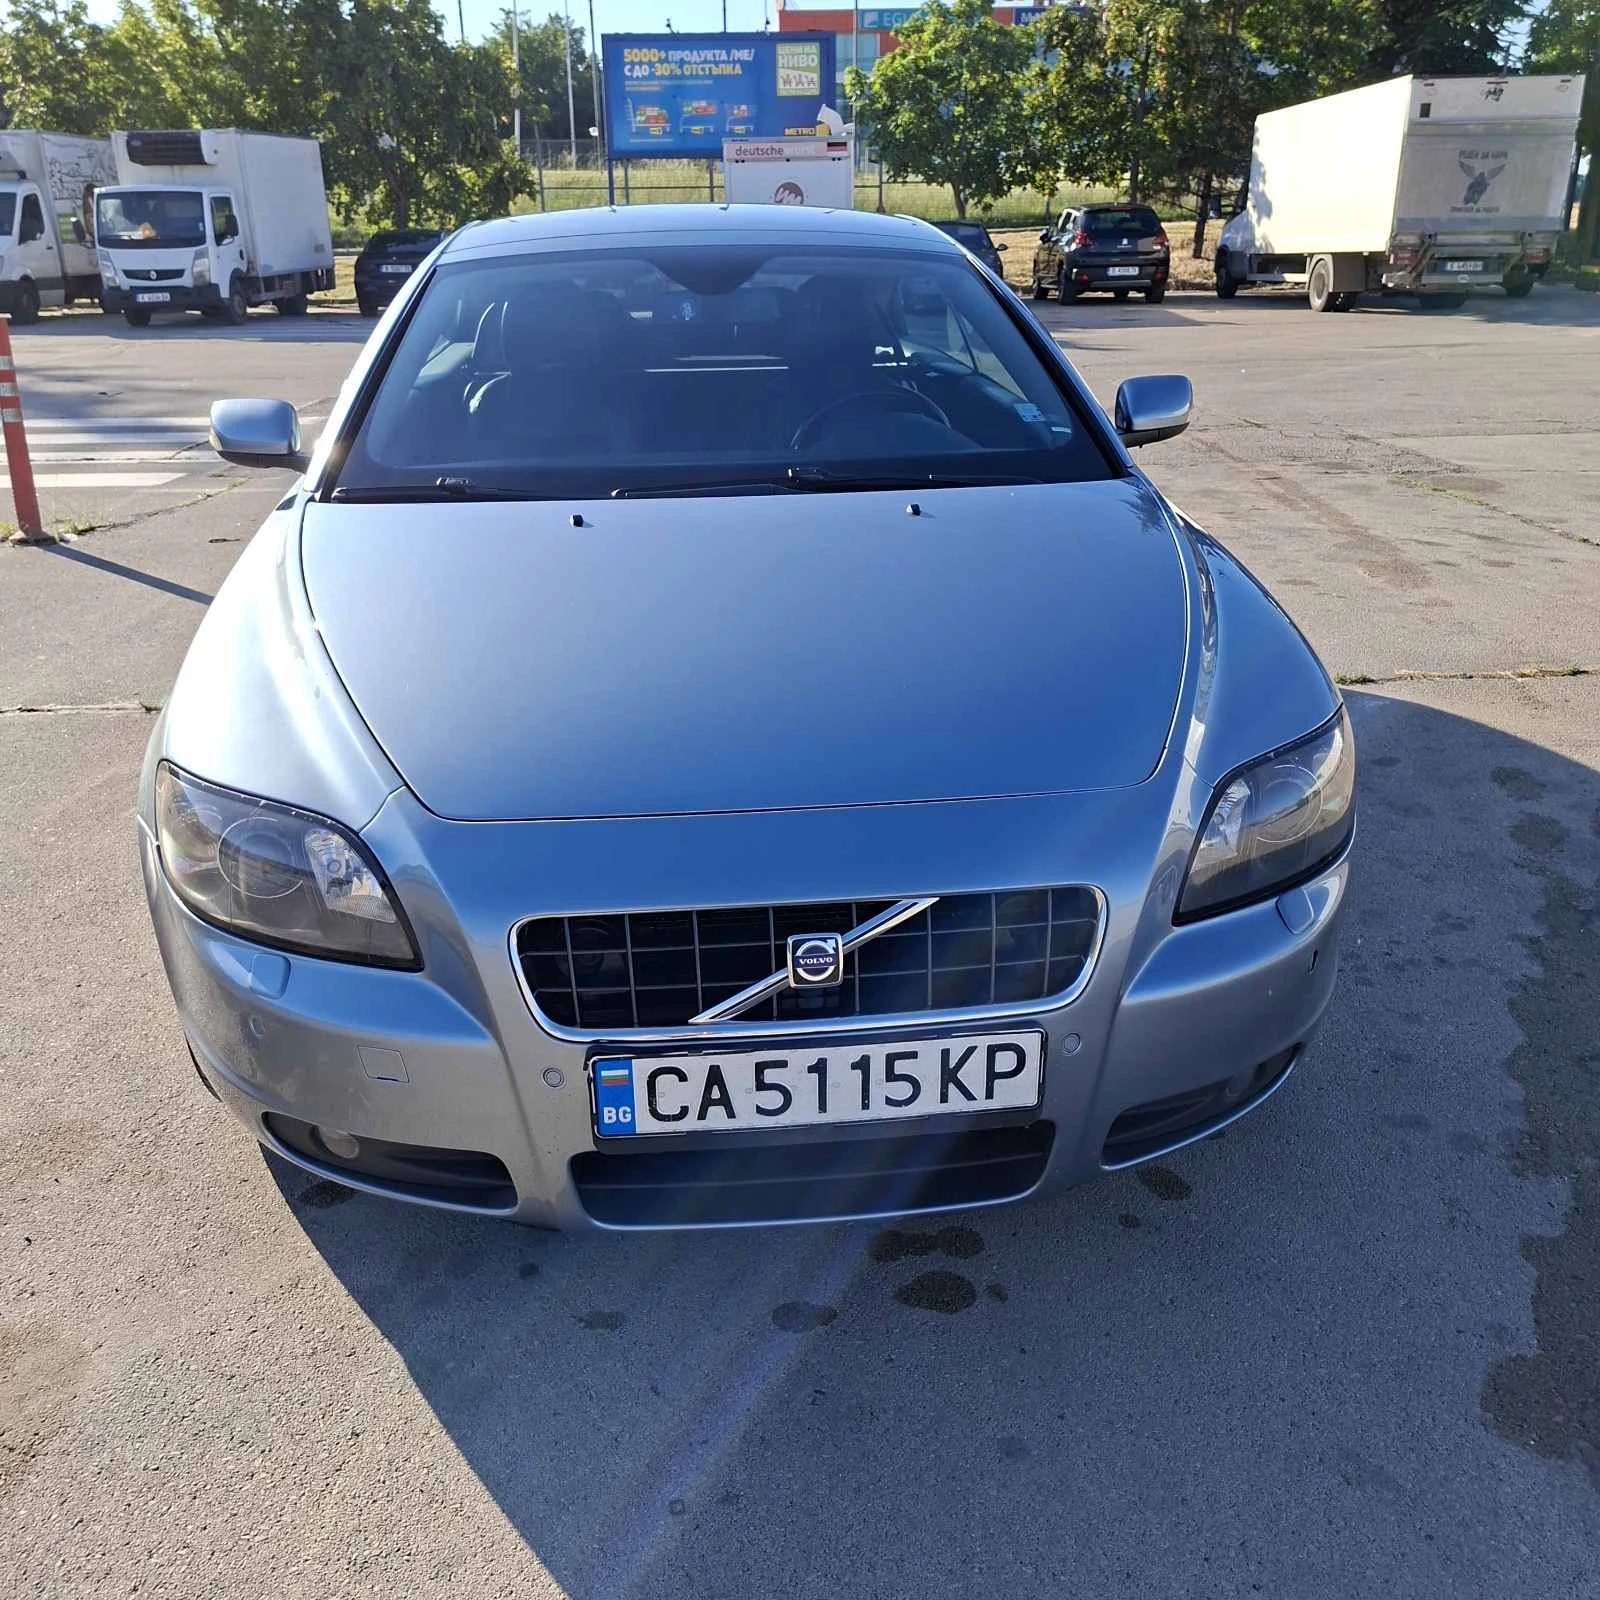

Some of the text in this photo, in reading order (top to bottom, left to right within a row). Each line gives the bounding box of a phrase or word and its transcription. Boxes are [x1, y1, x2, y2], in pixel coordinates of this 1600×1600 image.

[623, 48, 667, 62] 5000+
[668, 49, 728, 63] ПРОДУКТА
[779, 54, 817, 68] НИВО
[683, 63, 742, 76] ОТСТЪПКА
[784, 127, 815, 136] METRO
[735, 145, 784, 157] deutsche
[799, 956, 833, 965] VOLVO
[603, 1105, 632, 1124] BG
